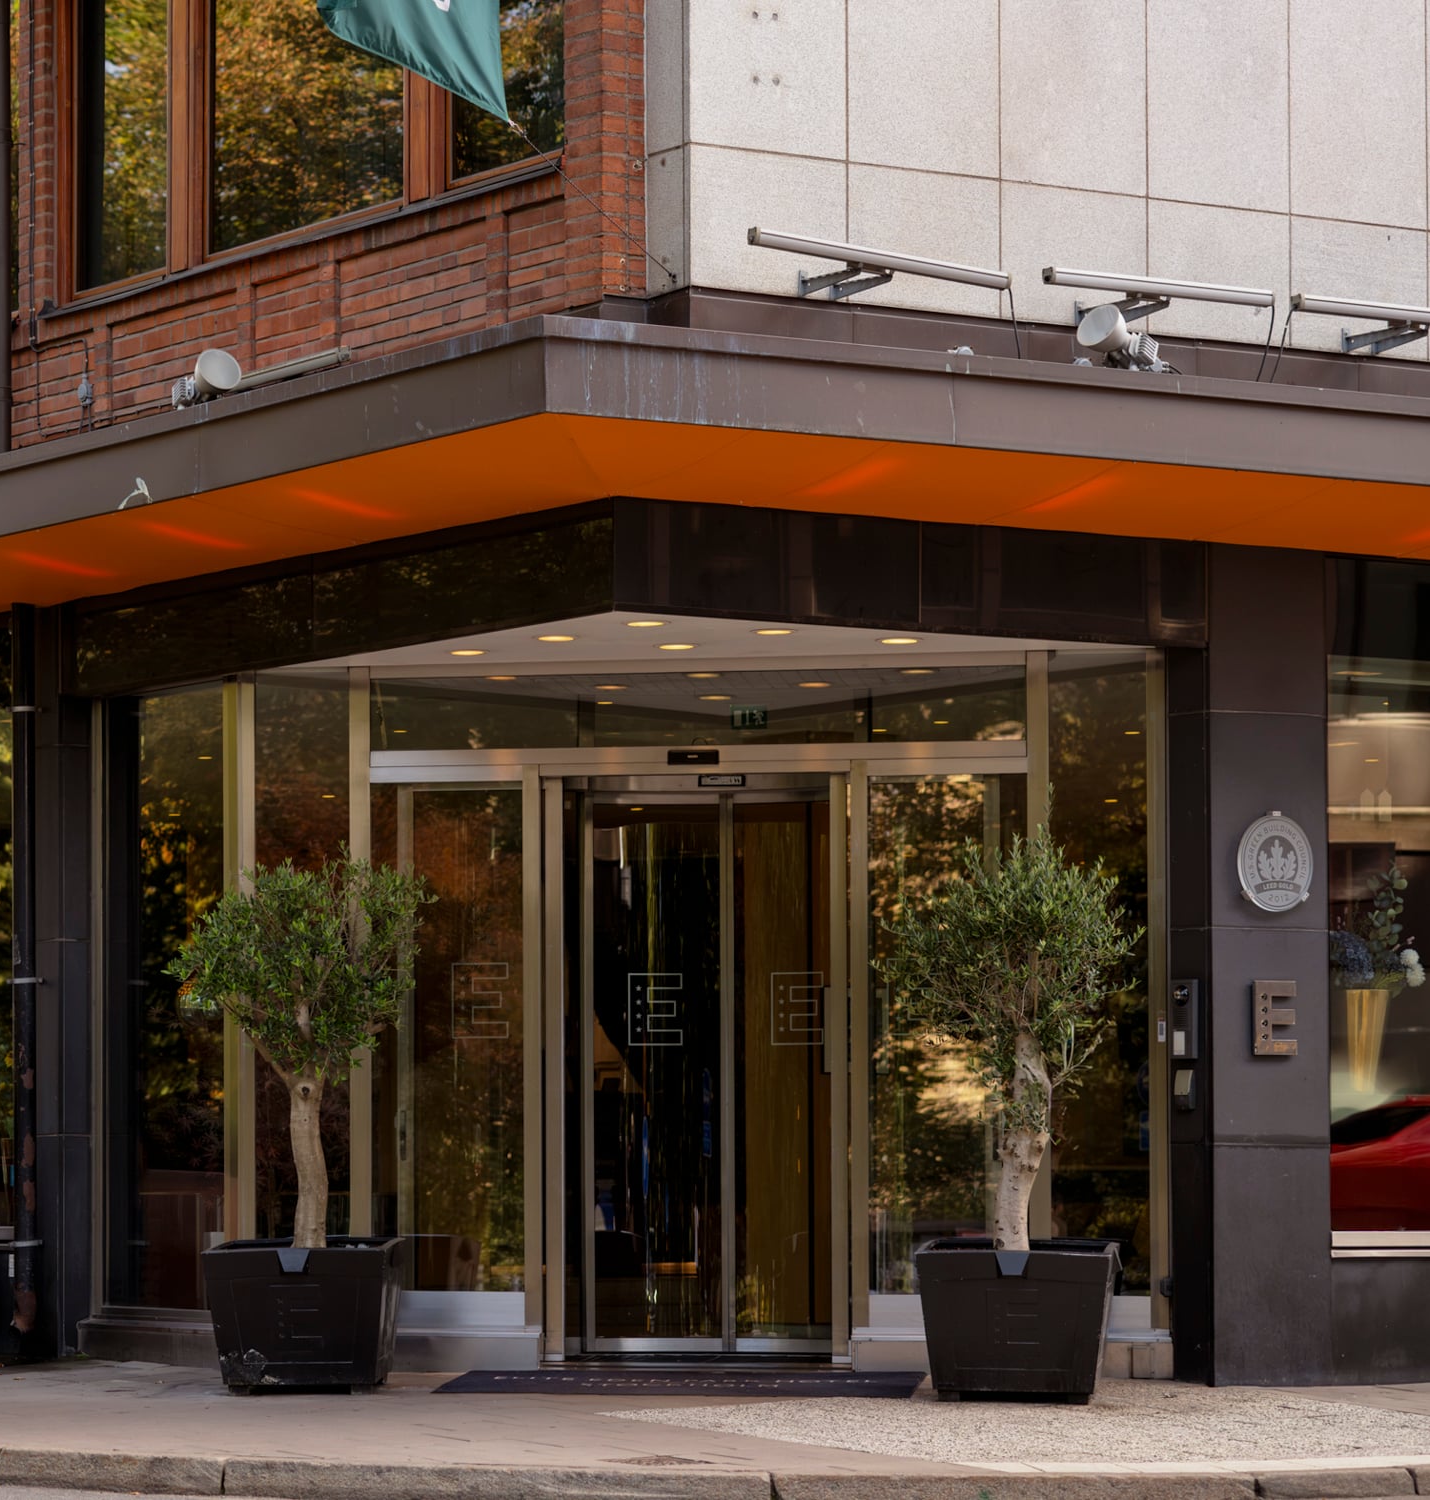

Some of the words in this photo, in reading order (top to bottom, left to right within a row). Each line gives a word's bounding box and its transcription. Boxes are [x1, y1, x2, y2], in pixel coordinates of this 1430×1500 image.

[1263, 824, 1297, 840] BUILDING
[1296, 840, 1307, 880] COUNCIL
[451, 962, 509, 1039] E
[627, 972, 684, 1046] E
[770, 971, 825, 1046] E
[1252, 979, 1298, 1056] E
